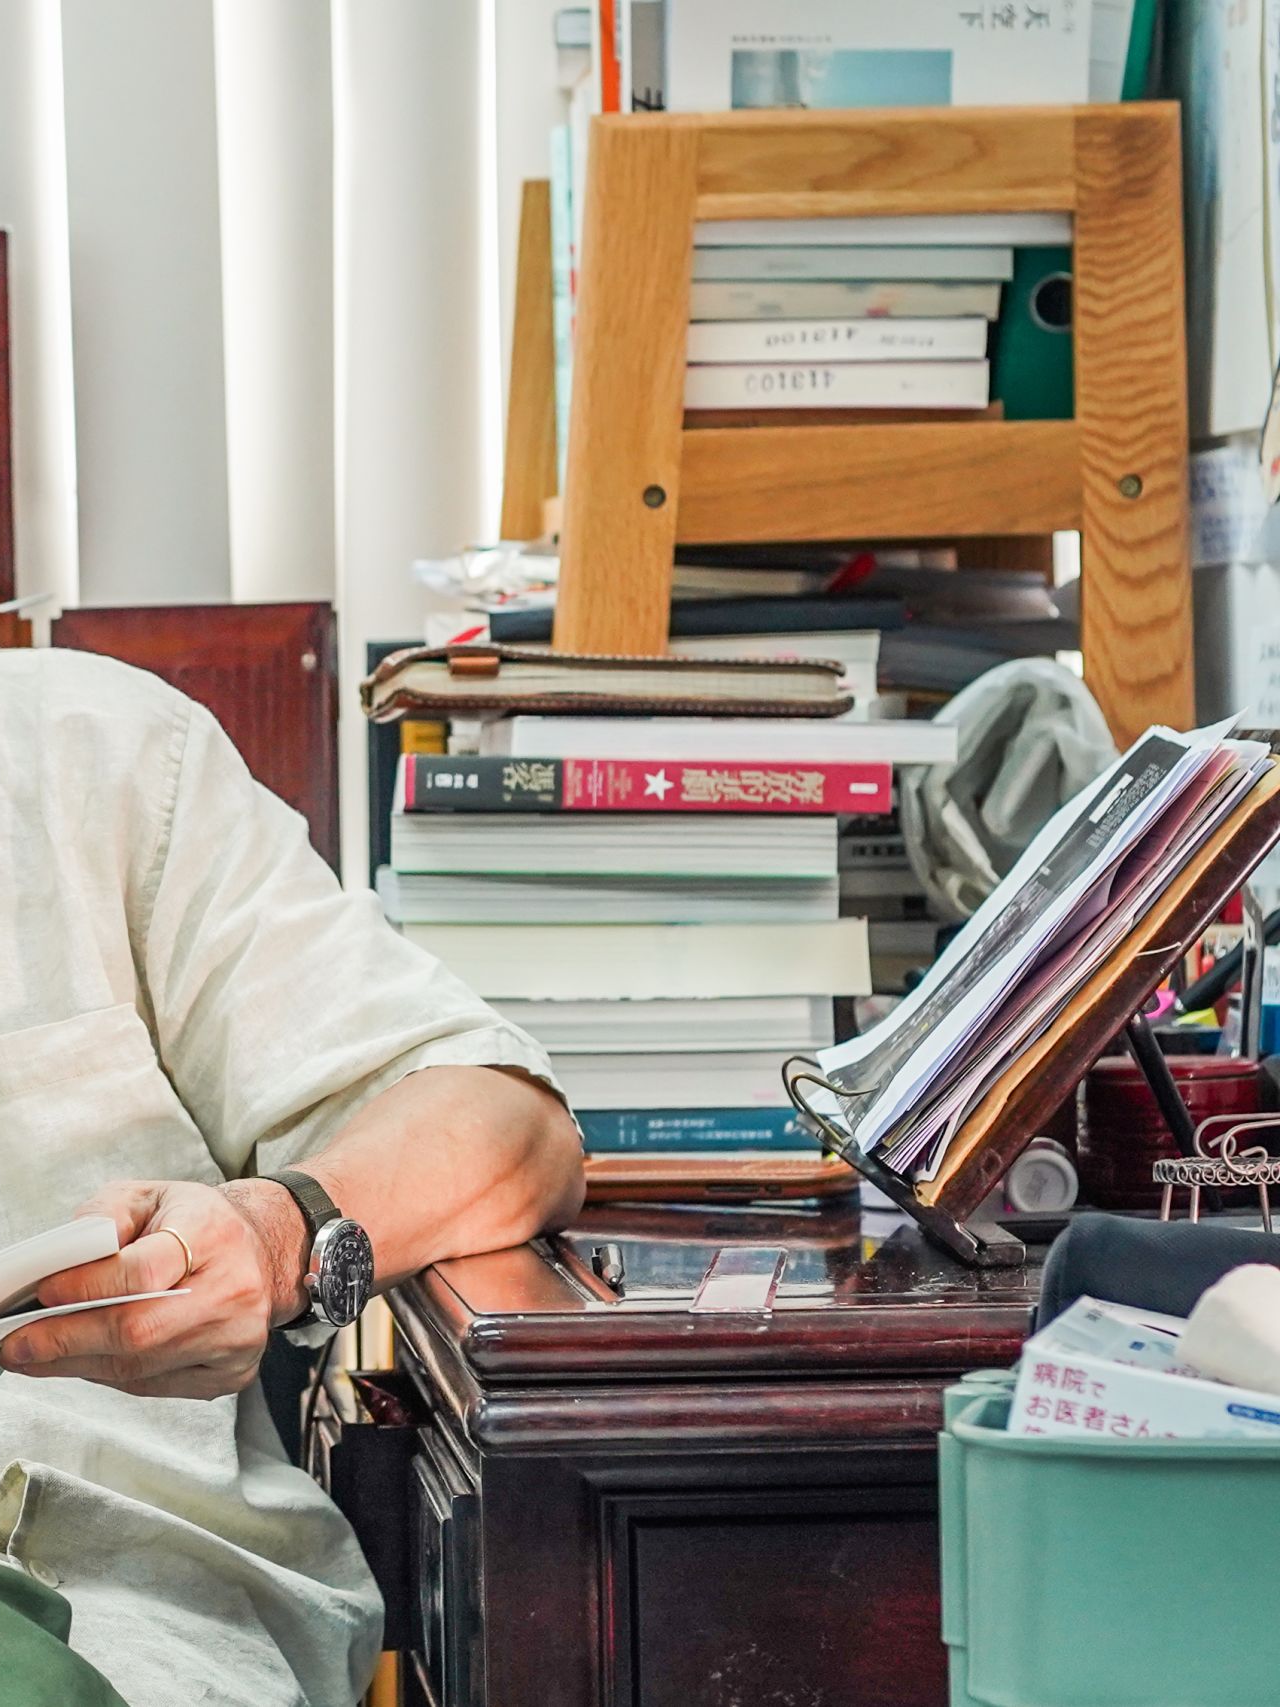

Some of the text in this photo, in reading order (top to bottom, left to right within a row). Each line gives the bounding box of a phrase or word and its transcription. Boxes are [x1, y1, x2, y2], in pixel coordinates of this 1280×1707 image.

[1025, 1395, 1179, 1439] お医者さん
